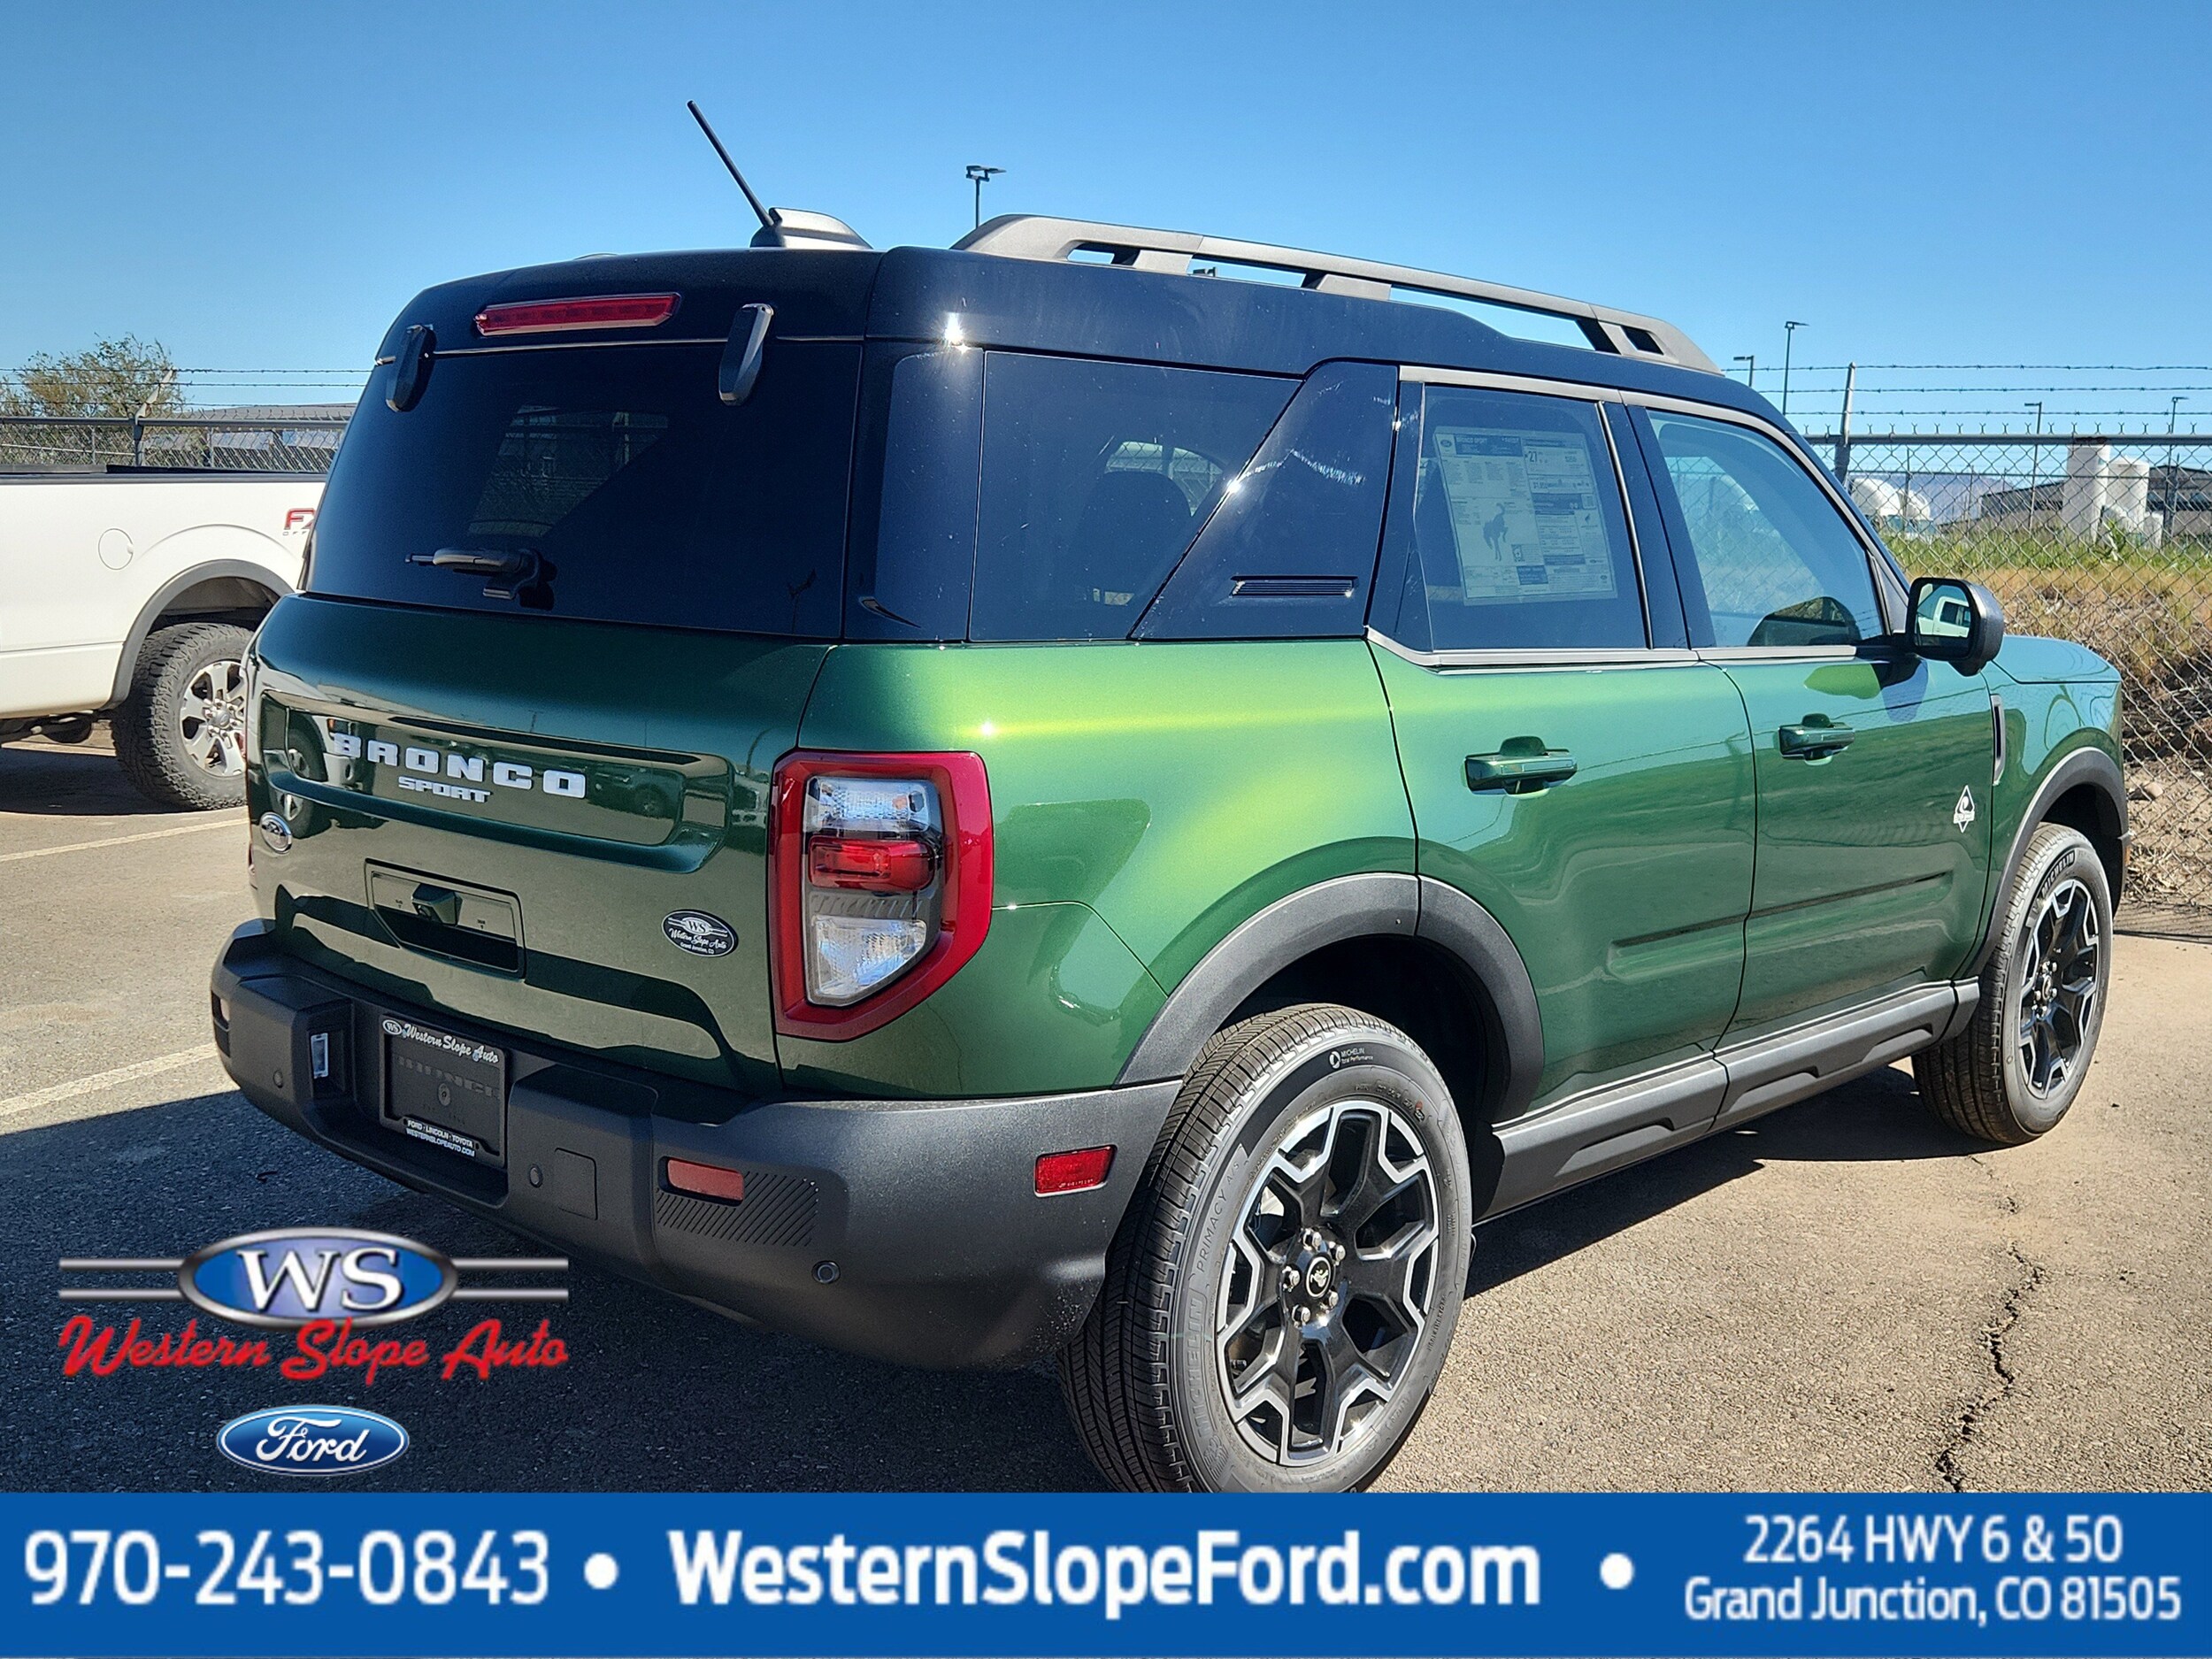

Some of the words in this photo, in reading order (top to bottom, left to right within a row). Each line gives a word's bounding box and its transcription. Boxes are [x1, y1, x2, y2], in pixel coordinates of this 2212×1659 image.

[334, 732, 587, 799] BRONCO
[398, 776, 490, 803] SPORT
[2041, 850, 2075, 899] MICHELIN
[685, 920, 709, 933] WS
[387, 1023, 399, 1033] WS
[403, 1023, 442, 1047] Western
[442, 1034, 472, 1056] Slope
[472, 1045, 499, 1063] Auto
[1196, 1188, 1227, 1272] PRIMACY
